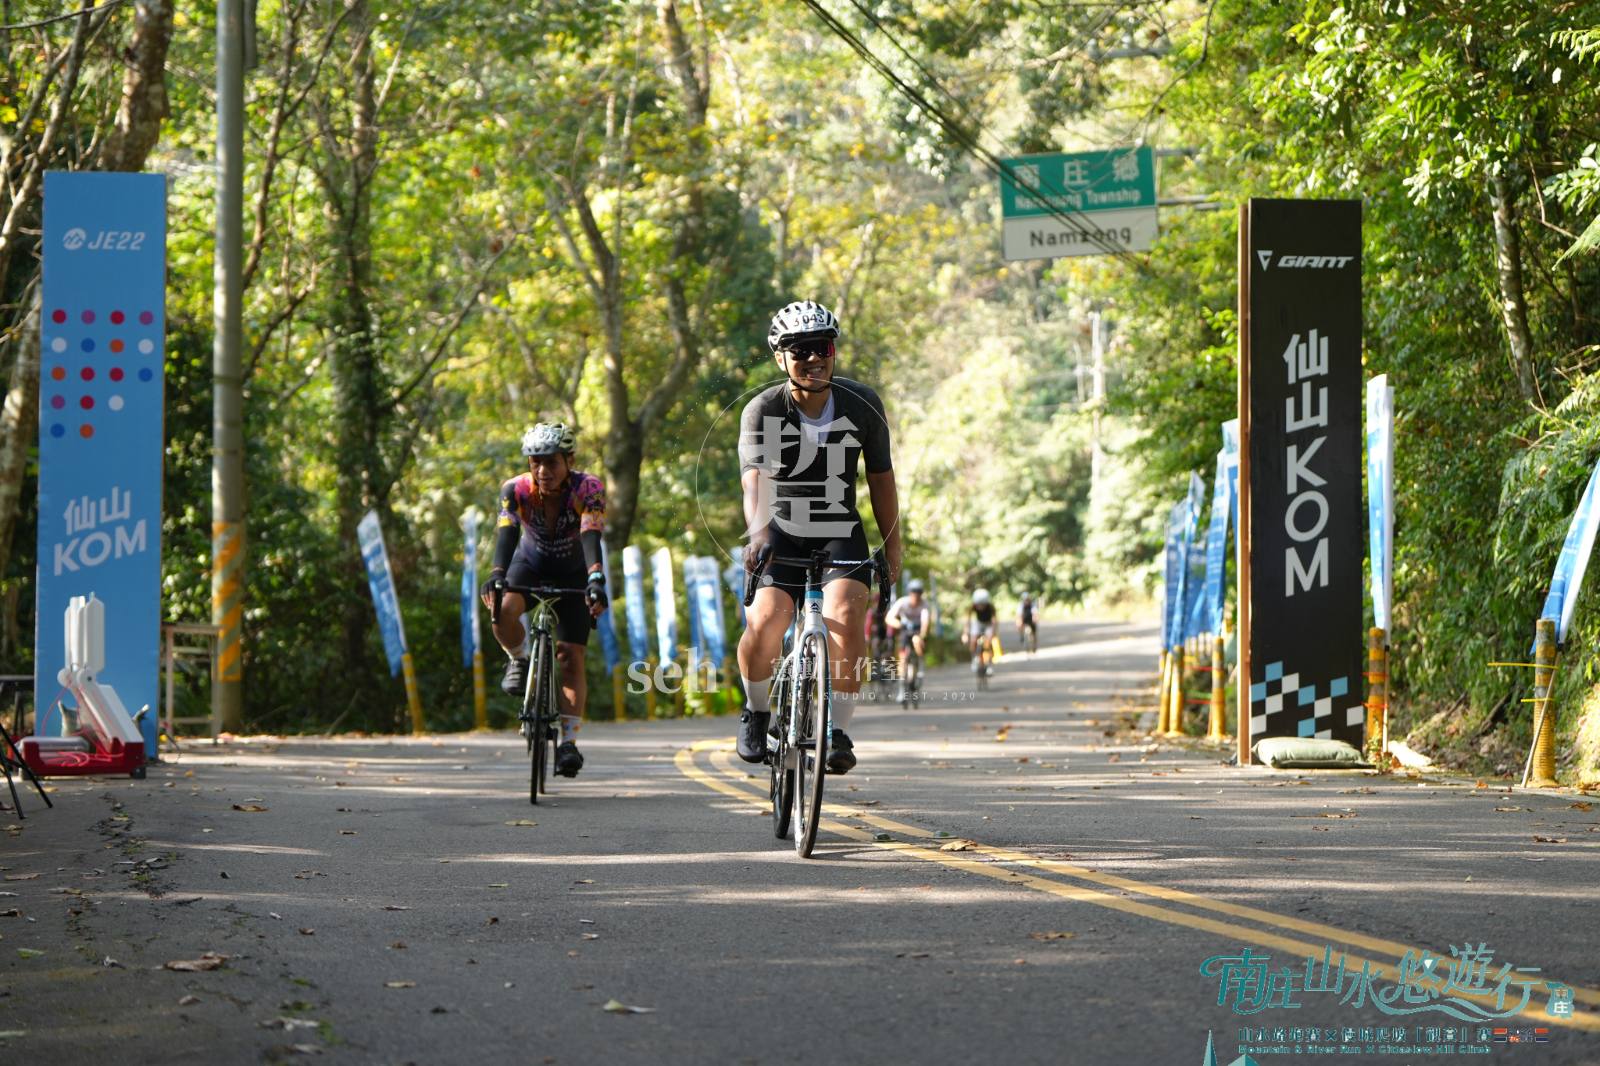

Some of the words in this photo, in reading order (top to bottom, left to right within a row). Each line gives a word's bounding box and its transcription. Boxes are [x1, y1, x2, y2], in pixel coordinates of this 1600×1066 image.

[87, 231, 146, 250] JE22
[1277, 255, 1354, 268] GIANT
[63, 486, 131, 536] 仙山
[54, 519, 146, 576] KOM
